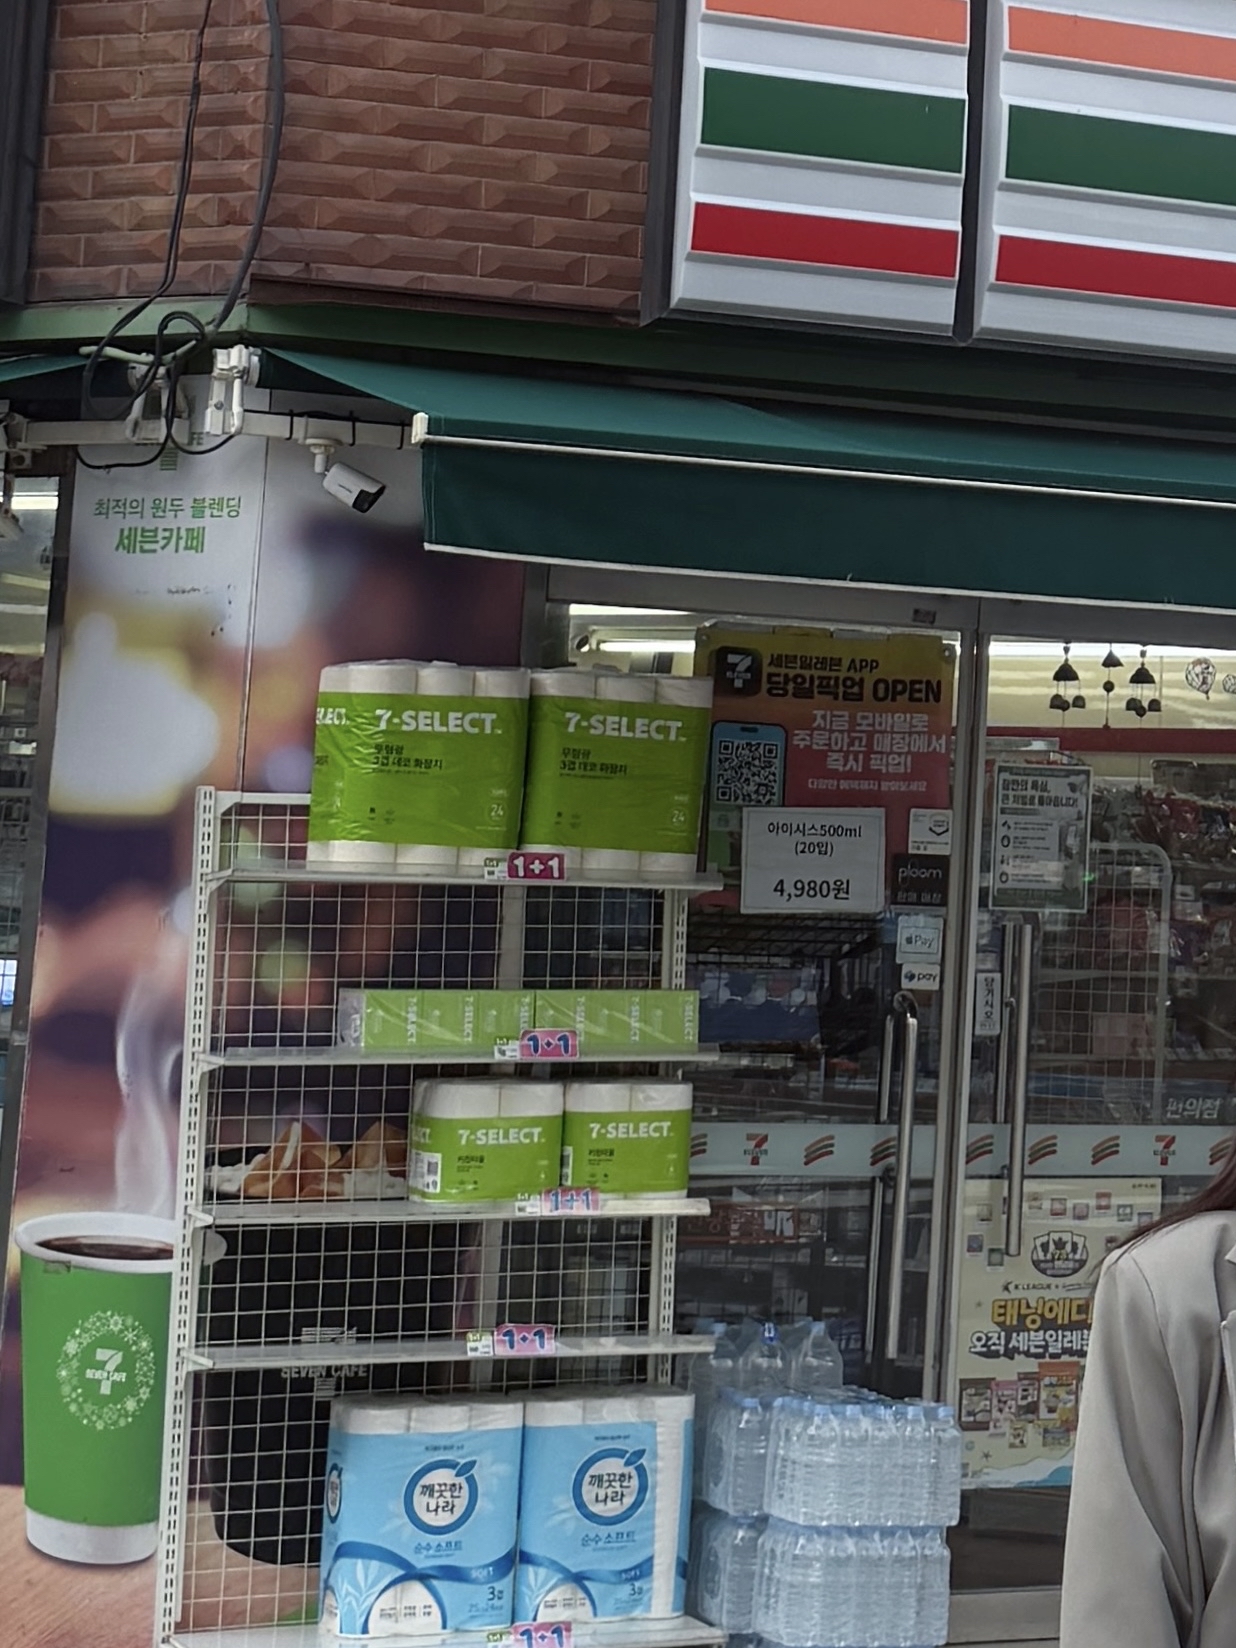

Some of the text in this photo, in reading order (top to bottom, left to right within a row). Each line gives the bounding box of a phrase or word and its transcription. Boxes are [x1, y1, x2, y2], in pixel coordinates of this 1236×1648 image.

[94, 496, 242, 519] 최적의 원두 블렌딩
[115, 526, 206, 554] 세븐카페
[768, 654, 879, 673] 세븐일레븐 APP
[766, 673, 942, 703] 당일픽업 OPEN
[375, 709, 498, 734] 7-SELECT
[564, 711, 684, 742] 7-SELECT
[812, 710, 929, 732] 지금 모바일로
[793, 729, 946, 753] 주문하고 매장에서
[826, 752, 912, 773] 즉시 픽업!
[768, 822, 862, 838] 아이시스500ml
[794, 841, 834, 857] (20입)
[513, 856, 560, 878] 1+1
[898, 859, 942, 886] ploom
[773, 879, 850, 902] 4,980원
[914, 934, 935, 949] Pay
[917, 972, 938, 984] pay
[527, 1032, 571, 1056] 1+1
[1166, 1097, 1221, 1119] 편의점
[457, 1127, 542, 1146] 7-SELECT
[589, 1121, 671, 1140] 7-SELECT
[551, 1189, 593, 1211] 1+1
[502, 1329, 546, 1350] 1+1
[970, 1331, 1005, 1355] 오직
[96, 1348, 123, 1395] 7
[419, 1482, 464, 1499] 깨끗한
[588, 1471, 633, 1489] 깨끗한
[426, 1501, 456, 1515] 나라
[594, 1490, 626, 1506] 나라
